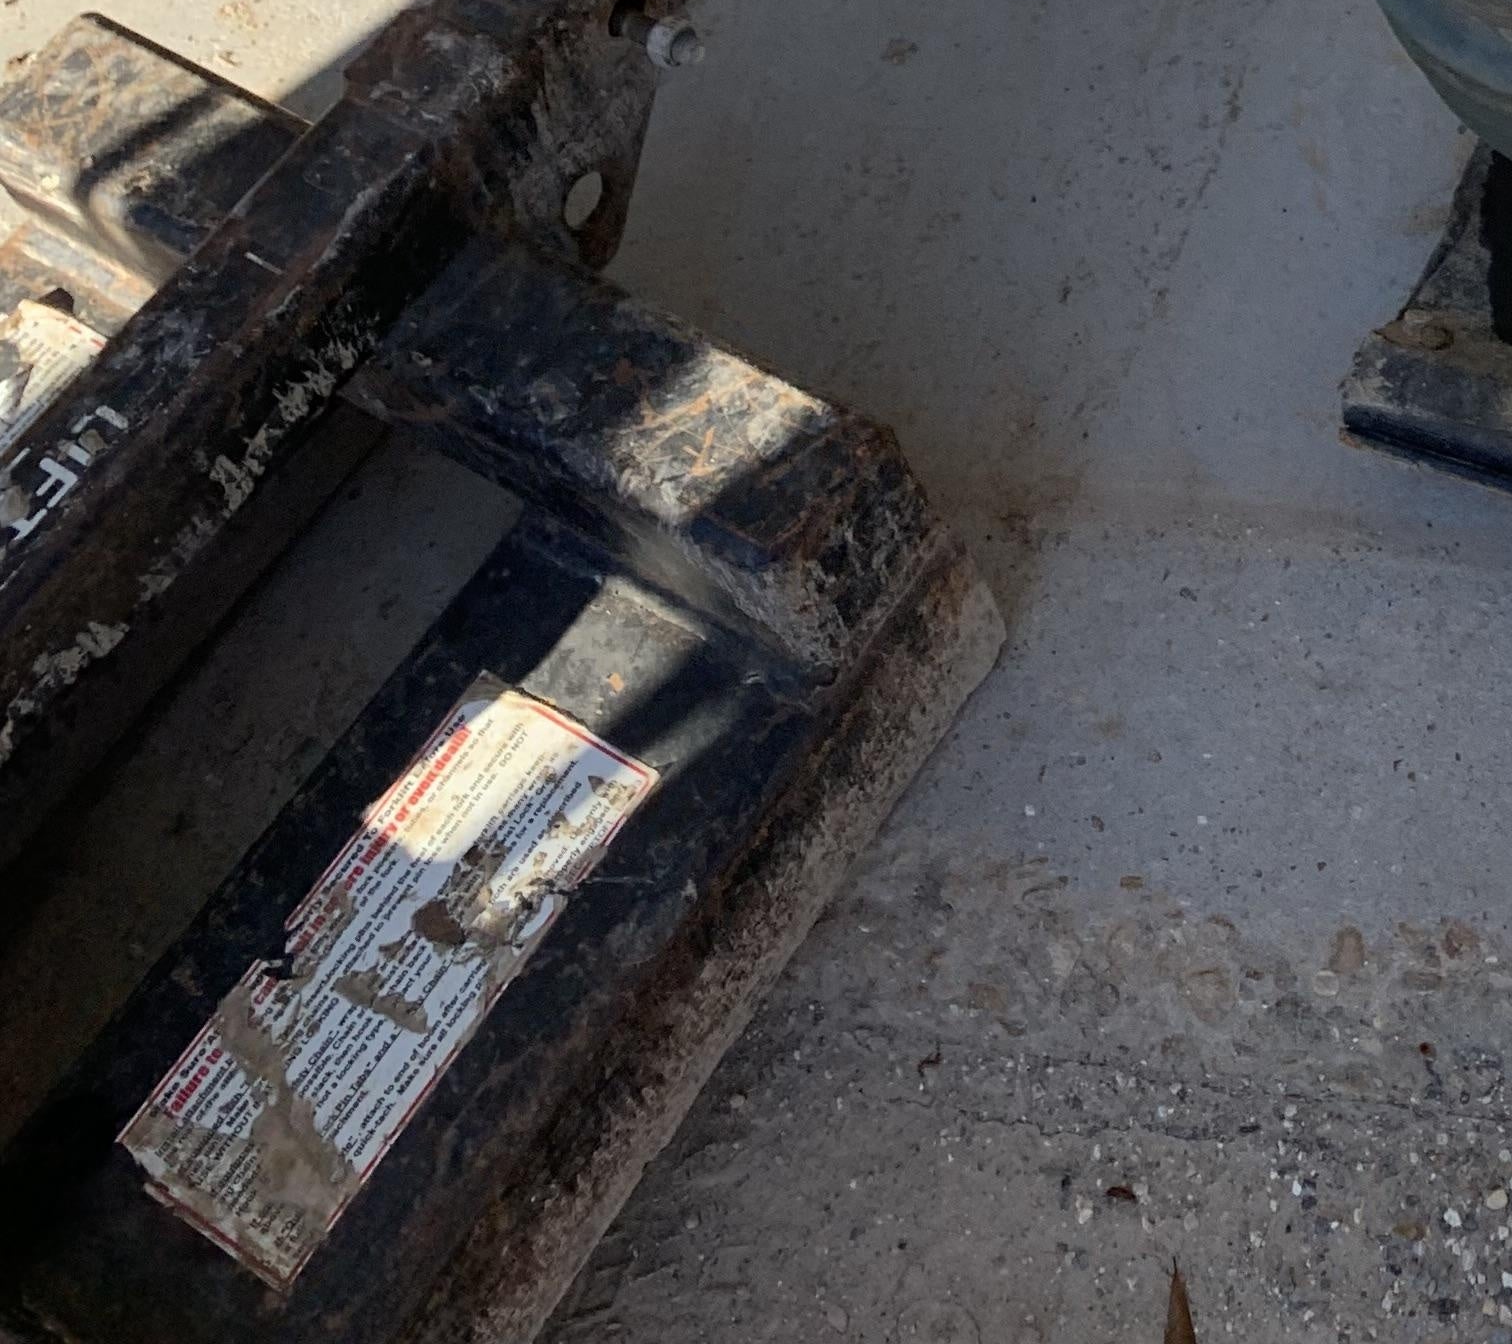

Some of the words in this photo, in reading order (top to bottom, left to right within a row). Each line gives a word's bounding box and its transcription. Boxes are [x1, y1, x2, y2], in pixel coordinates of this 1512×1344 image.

[359, 820, 400, 868] injury
[393, 804, 412, 823] or
[407, 772, 437, 806] even
[362, 825, 378, 843] To
[376, 779, 414, 825] Forklift
[443, 712, 467, 738] Use
